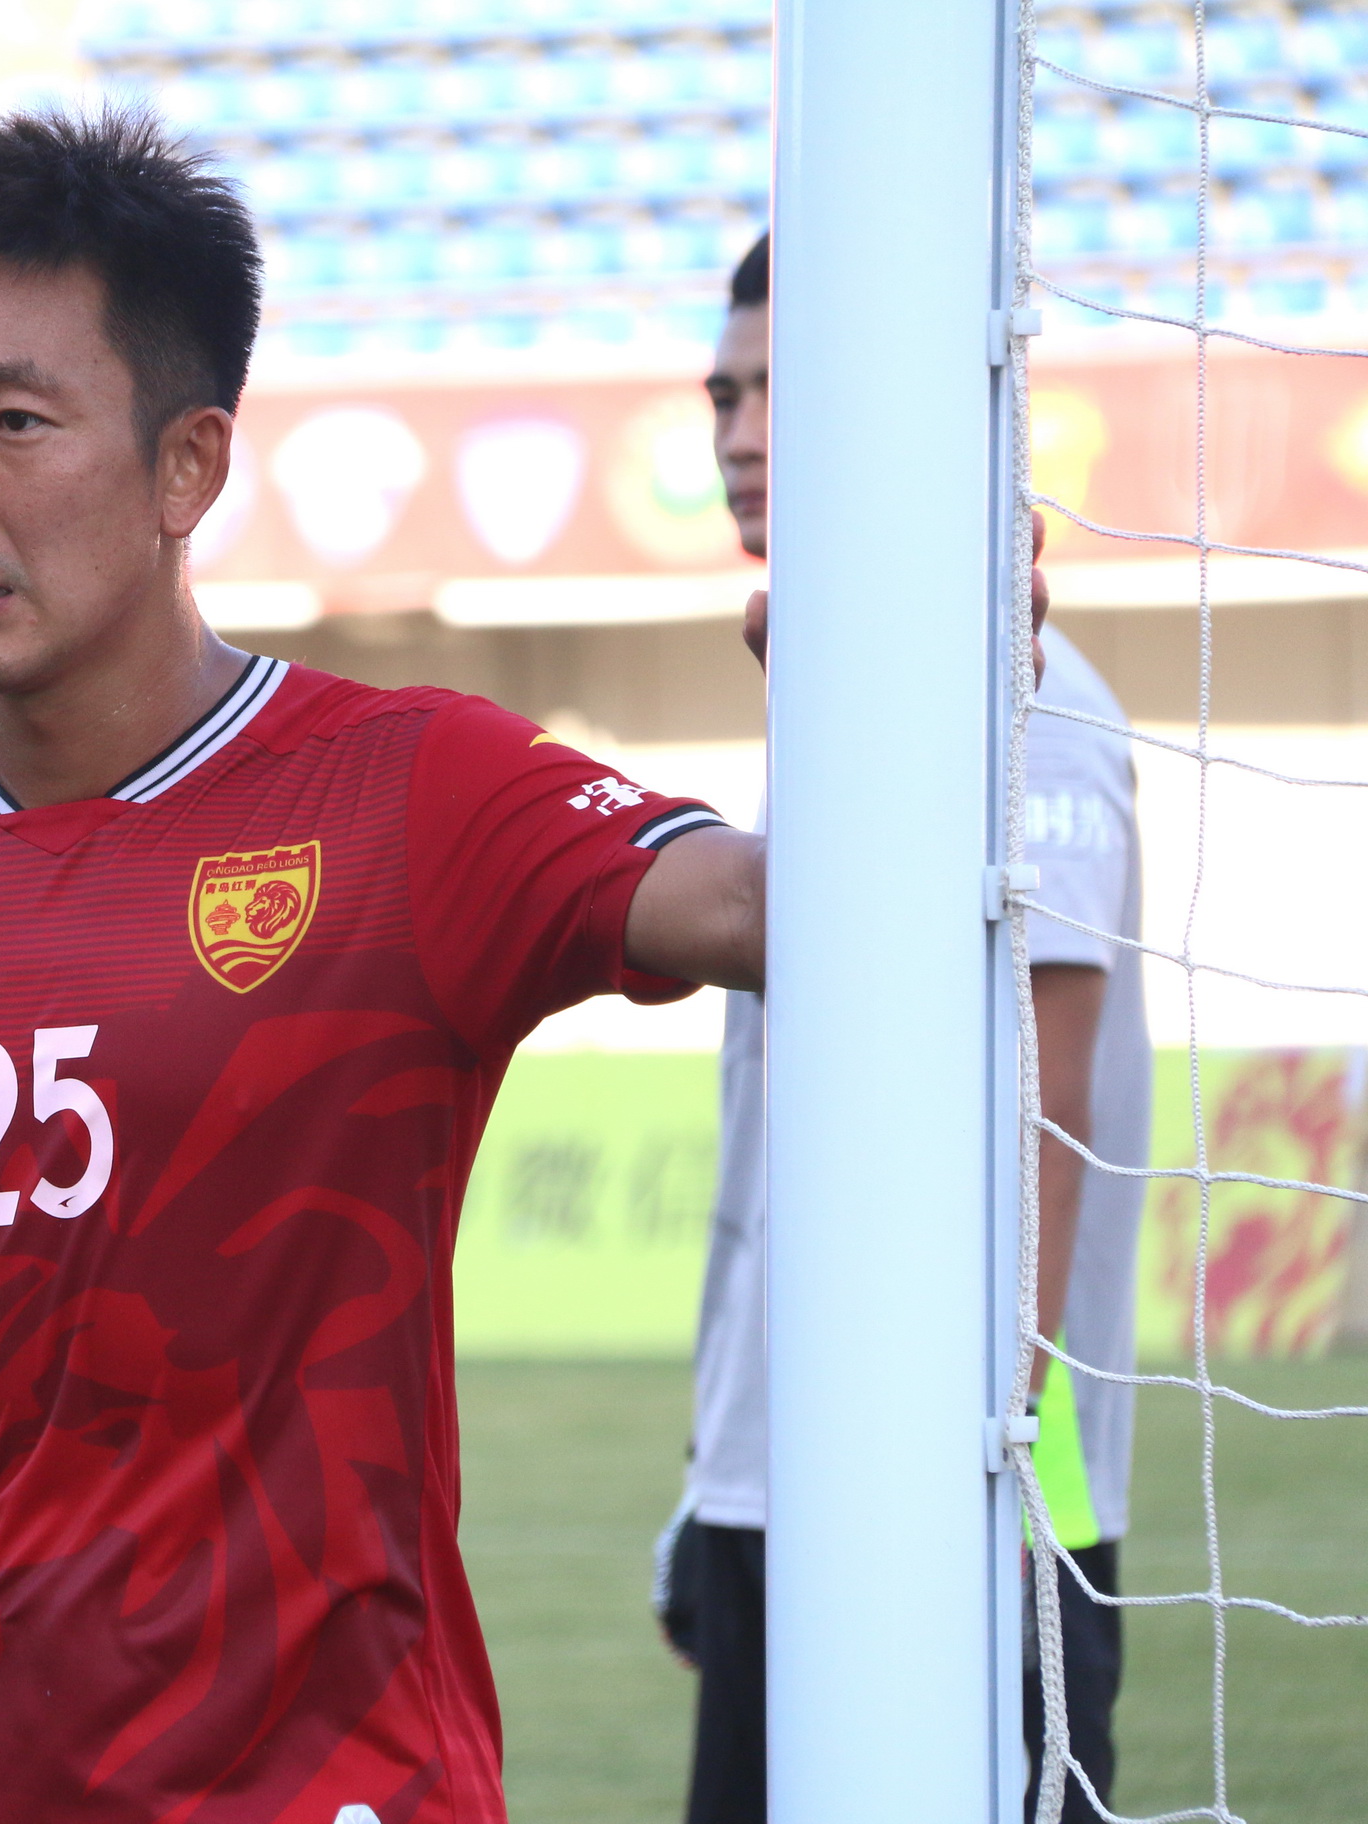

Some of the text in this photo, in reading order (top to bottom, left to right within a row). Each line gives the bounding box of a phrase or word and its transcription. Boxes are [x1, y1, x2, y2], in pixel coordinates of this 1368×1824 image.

[206, 854, 310, 878] QINGDAO RED LIONS
